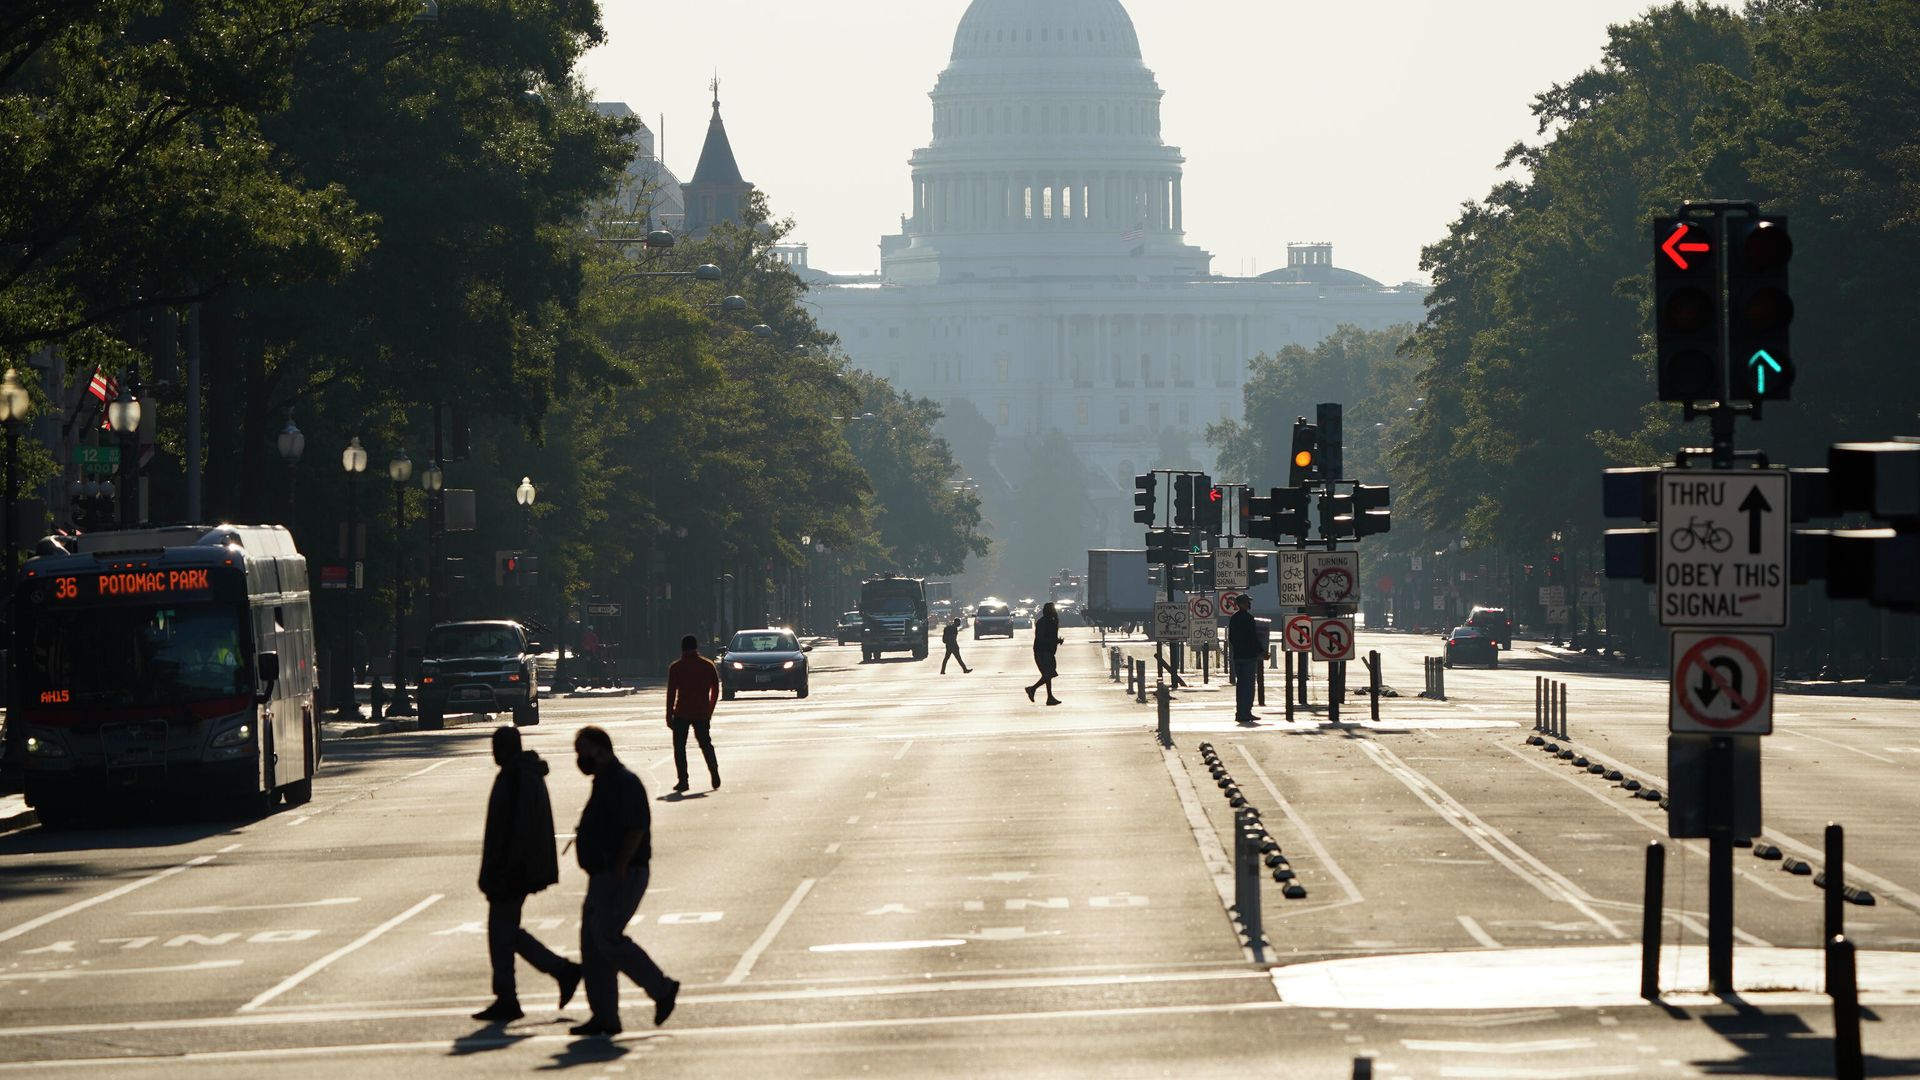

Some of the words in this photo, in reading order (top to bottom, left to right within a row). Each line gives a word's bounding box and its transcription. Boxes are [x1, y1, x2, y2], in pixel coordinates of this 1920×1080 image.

[81, 448, 98, 462] 12
[1668, 482, 1726, 506] THRU
[1282, 553, 1303, 564] THRU
[1317, 557, 1348, 567] TURNING
[1217, 570, 1231, 578] OBEY
[1666, 563, 1723, 587] OBEY
[1733, 563, 1780, 587] THIS
[55, 577, 78, 599] 36
[98, 571, 166, 595] POTOMAC
[169, 569, 209, 591] PARK
[1282, 583, 1302, 593] OBEY
[1281, 594, 1306, 603] SIGNA
[1666, 593, 1743, 616] SIGNAL
[40, 689, 70, 704] AH15
[19, 928, 322, 955] ONLY
